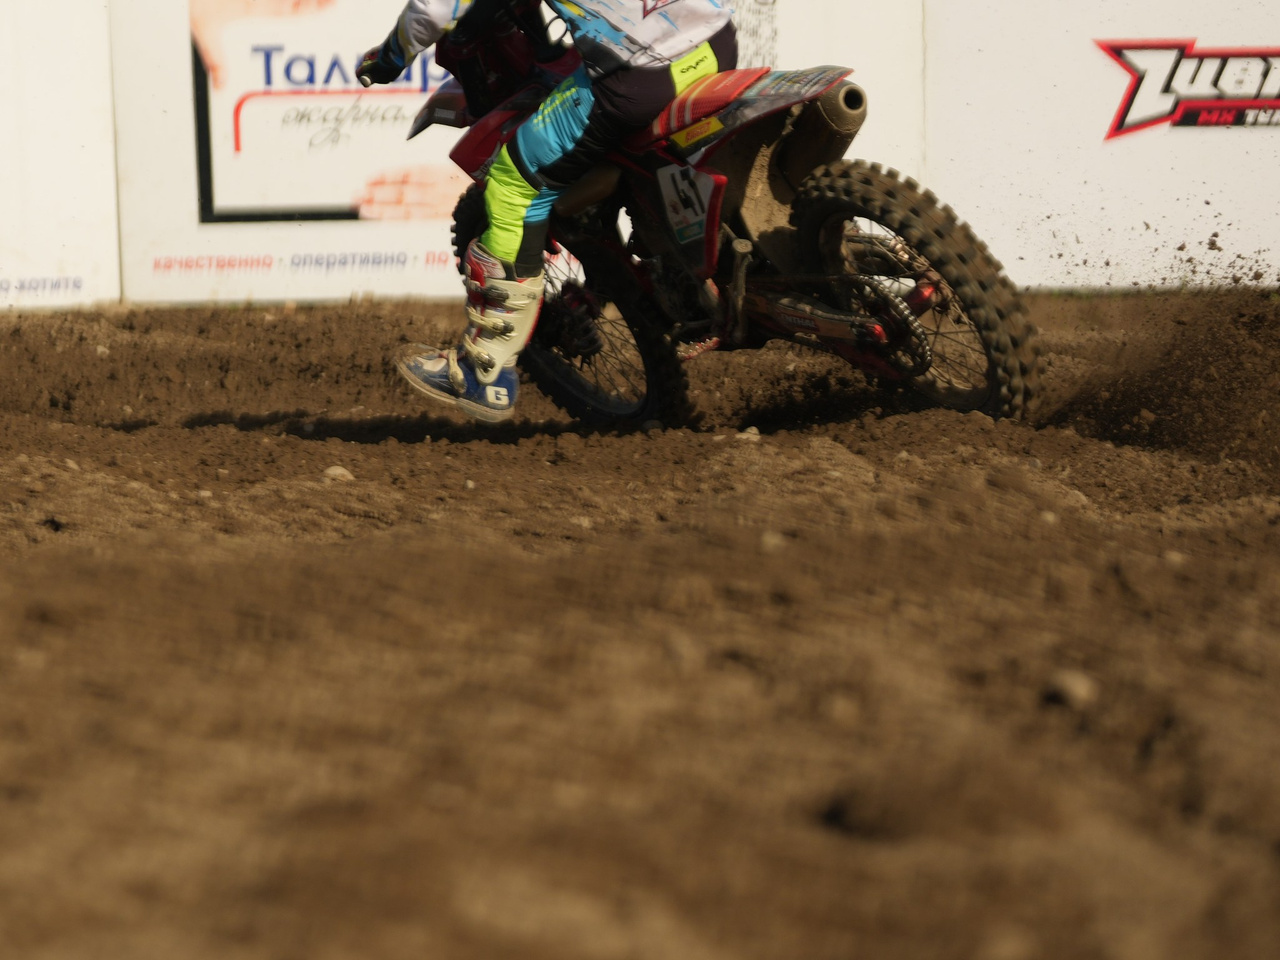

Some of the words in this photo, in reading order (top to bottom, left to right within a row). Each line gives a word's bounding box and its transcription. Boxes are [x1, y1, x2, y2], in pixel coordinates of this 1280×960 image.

[251, 43, 456, 93] Талр
[1197, 109, 1237, 126] MX
[153, 253, 274, 272] качественно
[290, 249, 407, 272] оперативно
[17, 276, 83, 291] хотите
